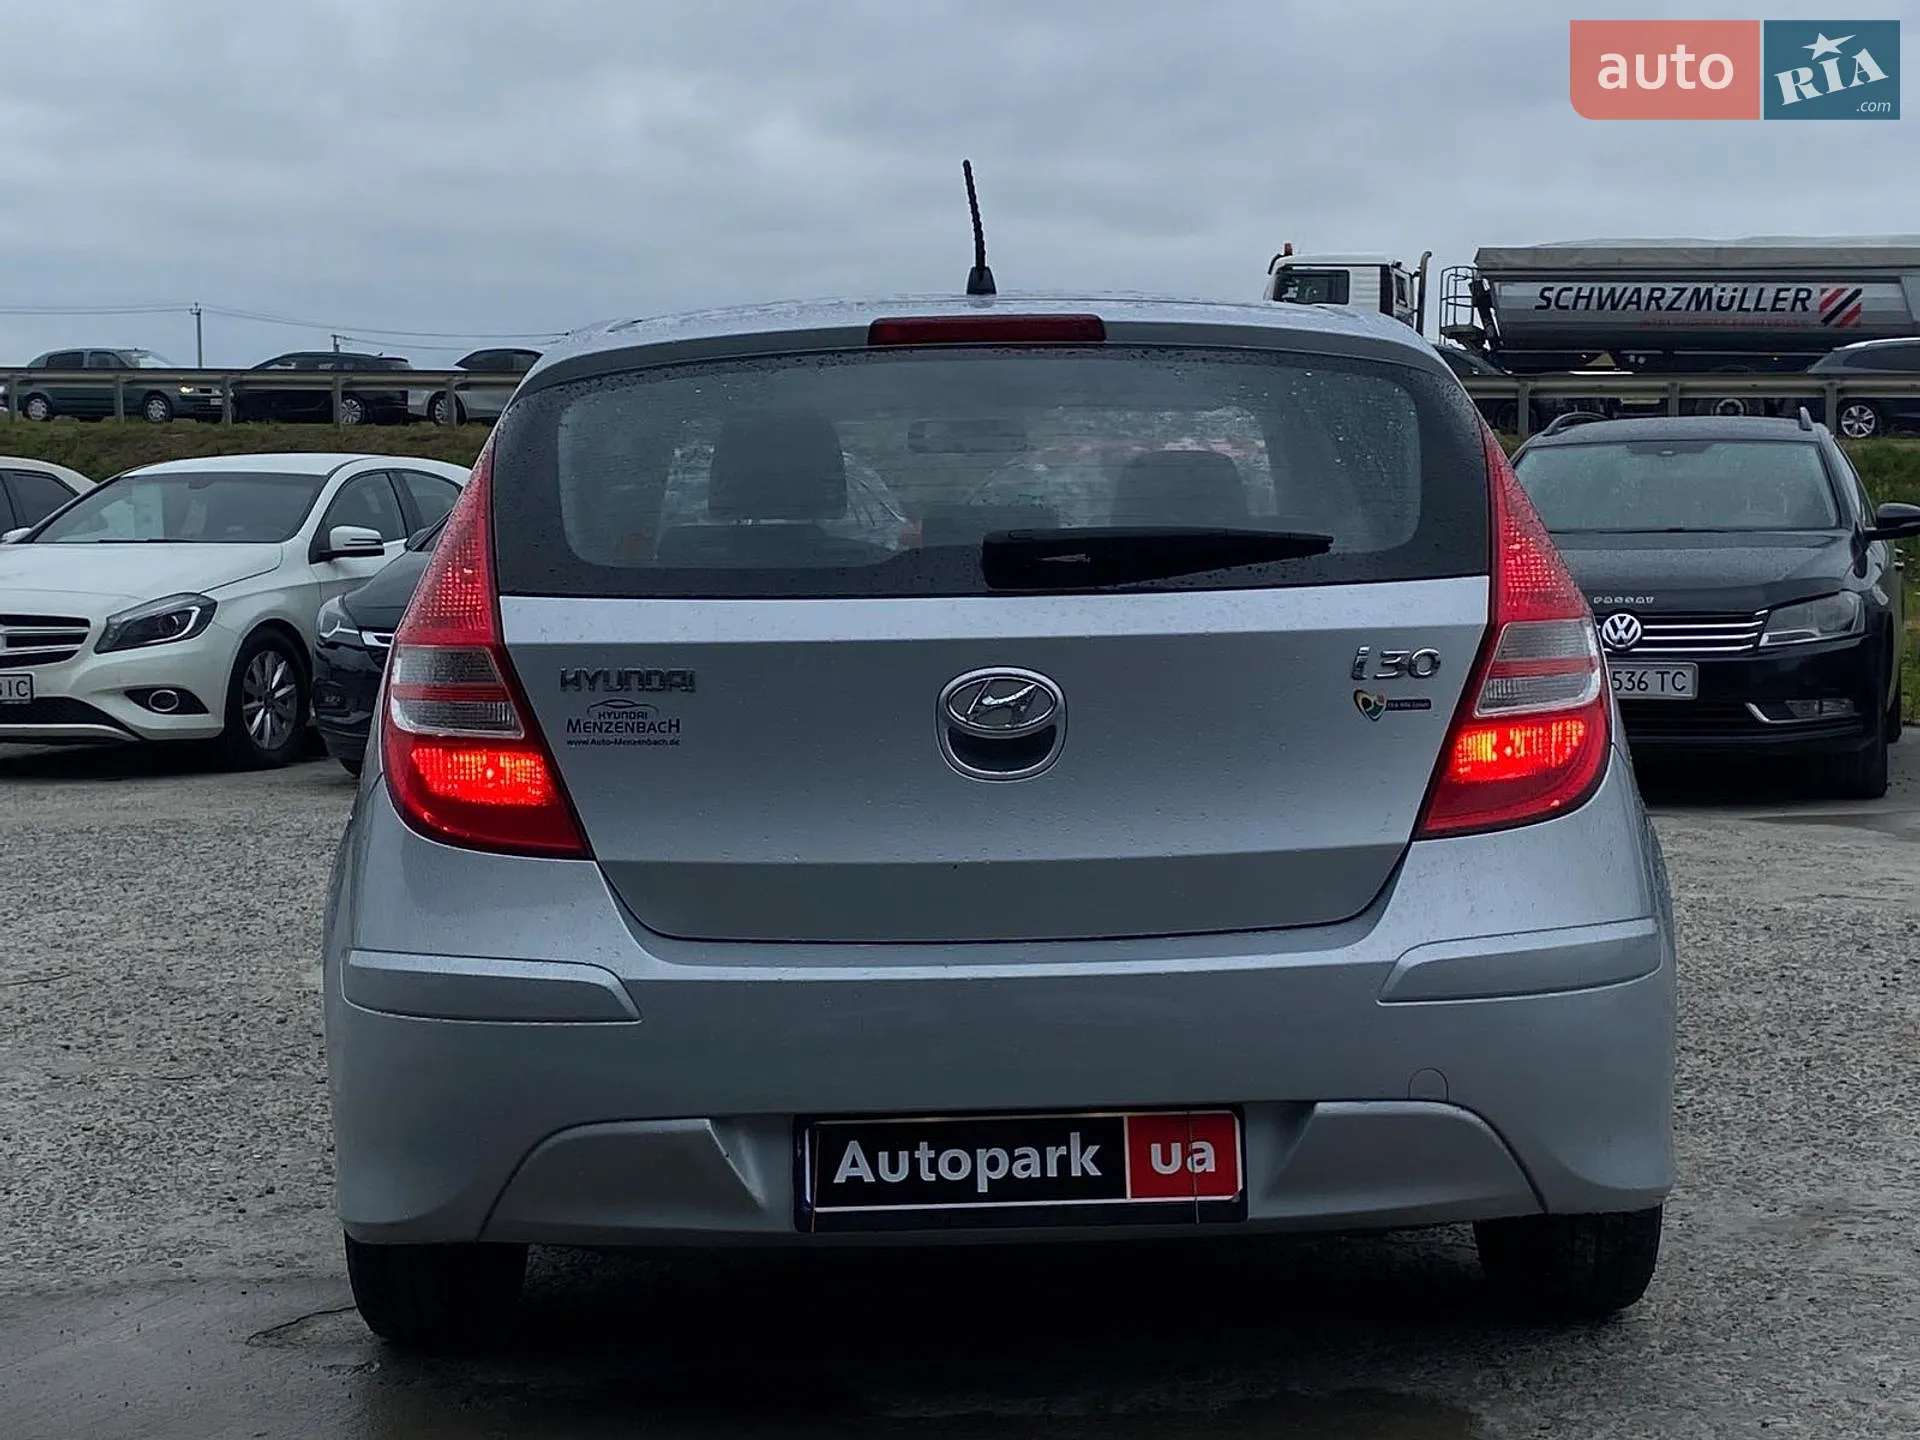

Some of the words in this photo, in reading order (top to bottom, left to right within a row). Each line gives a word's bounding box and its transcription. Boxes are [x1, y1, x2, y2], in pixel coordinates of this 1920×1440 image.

[1534, 286, 1812, 313] SCHWARZMÜLLER
[560, 667, 696, 692] HYUNDAI
[1656, 671, 1687, 692] TC
[598, 711, 648, 720] HYUNDAI
[833, 1131, 1102, 1193] Autopark
[1150, 1140, 1216, 1176] ua
